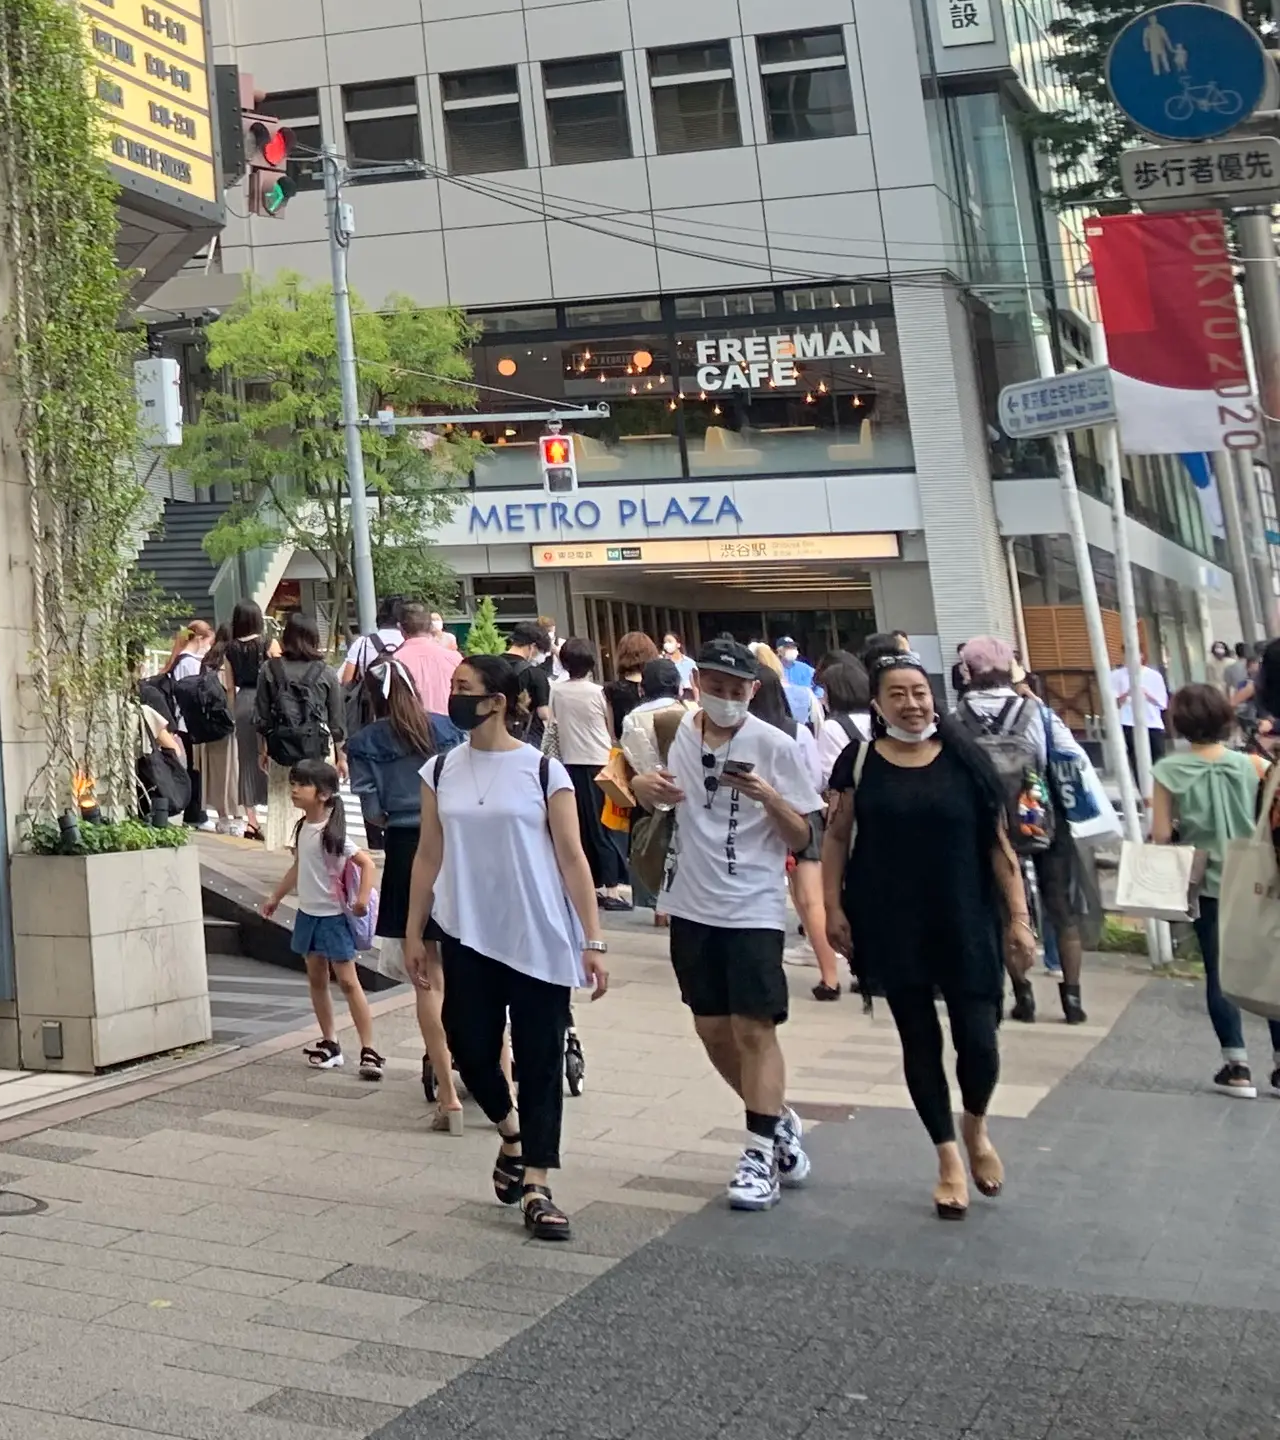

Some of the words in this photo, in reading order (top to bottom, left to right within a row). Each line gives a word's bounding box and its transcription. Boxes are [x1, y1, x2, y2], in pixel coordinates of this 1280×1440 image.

[1134, 150, 1273, 190] 歩行者優先
[1184, 209, 1240, 341] TOKYO
[696, 328, 882, 365] FREEMAN
[697, 361, 797, 391] CAFE
[1208, 352, 1262, 450] 2020
[468, 499, 601, 535] METRO
[620, 494, 744, 530] PLAZA
[720, 542, 768, 558] 渋谷駅
[725, 786, 740, 876] UPREME
